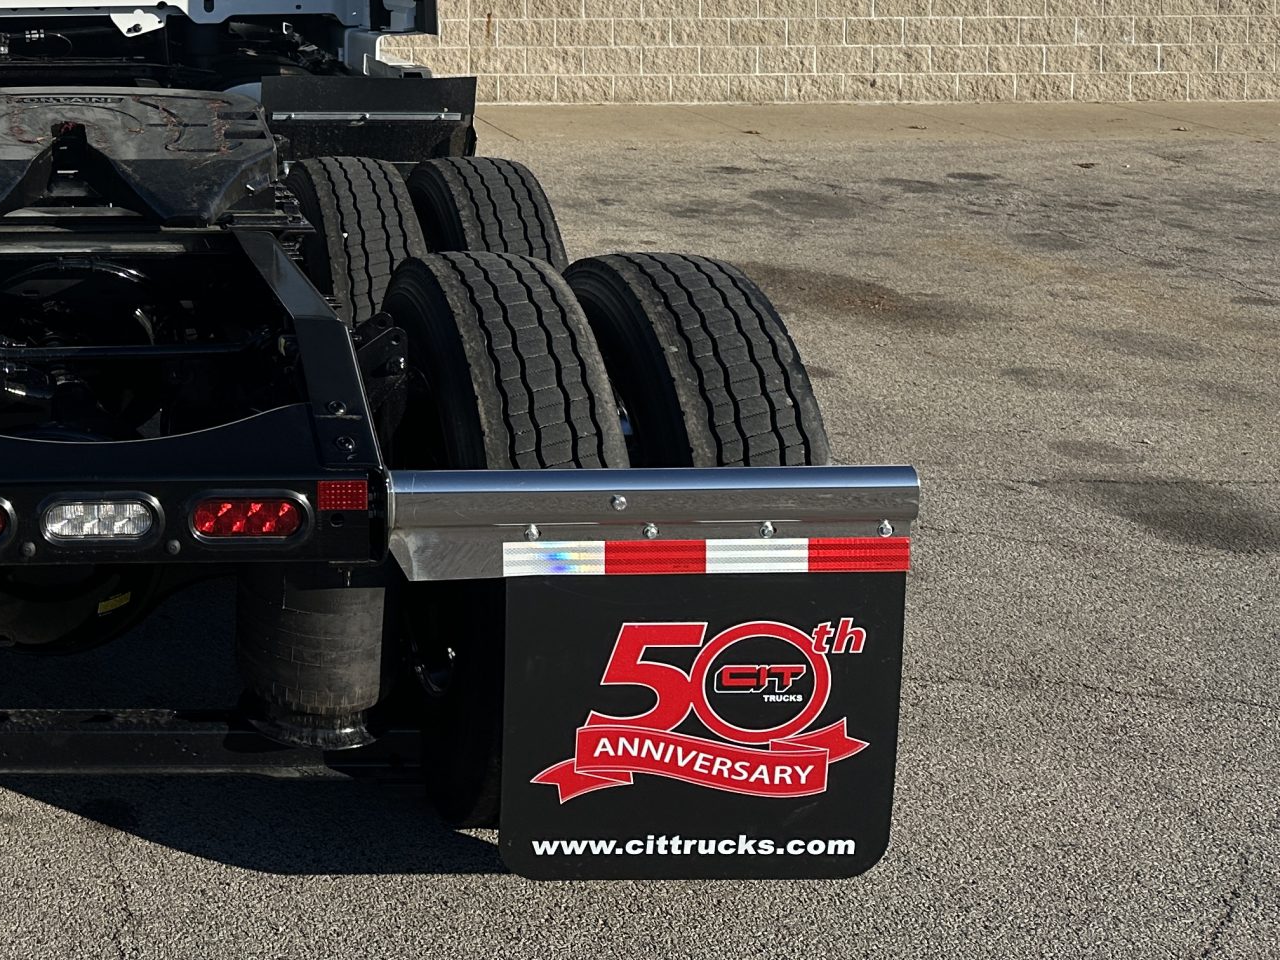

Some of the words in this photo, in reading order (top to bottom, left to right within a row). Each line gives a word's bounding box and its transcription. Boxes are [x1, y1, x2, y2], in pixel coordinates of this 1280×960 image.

[584, 617, 868, 745] 50th
[714, 665, 806, 693] CIT
[762, 694, 803, 702] TRUCKS
[593, 737, 815, 785] ANNIVERSARY
[531, 835, 855, 856] www.cittrucks.com
